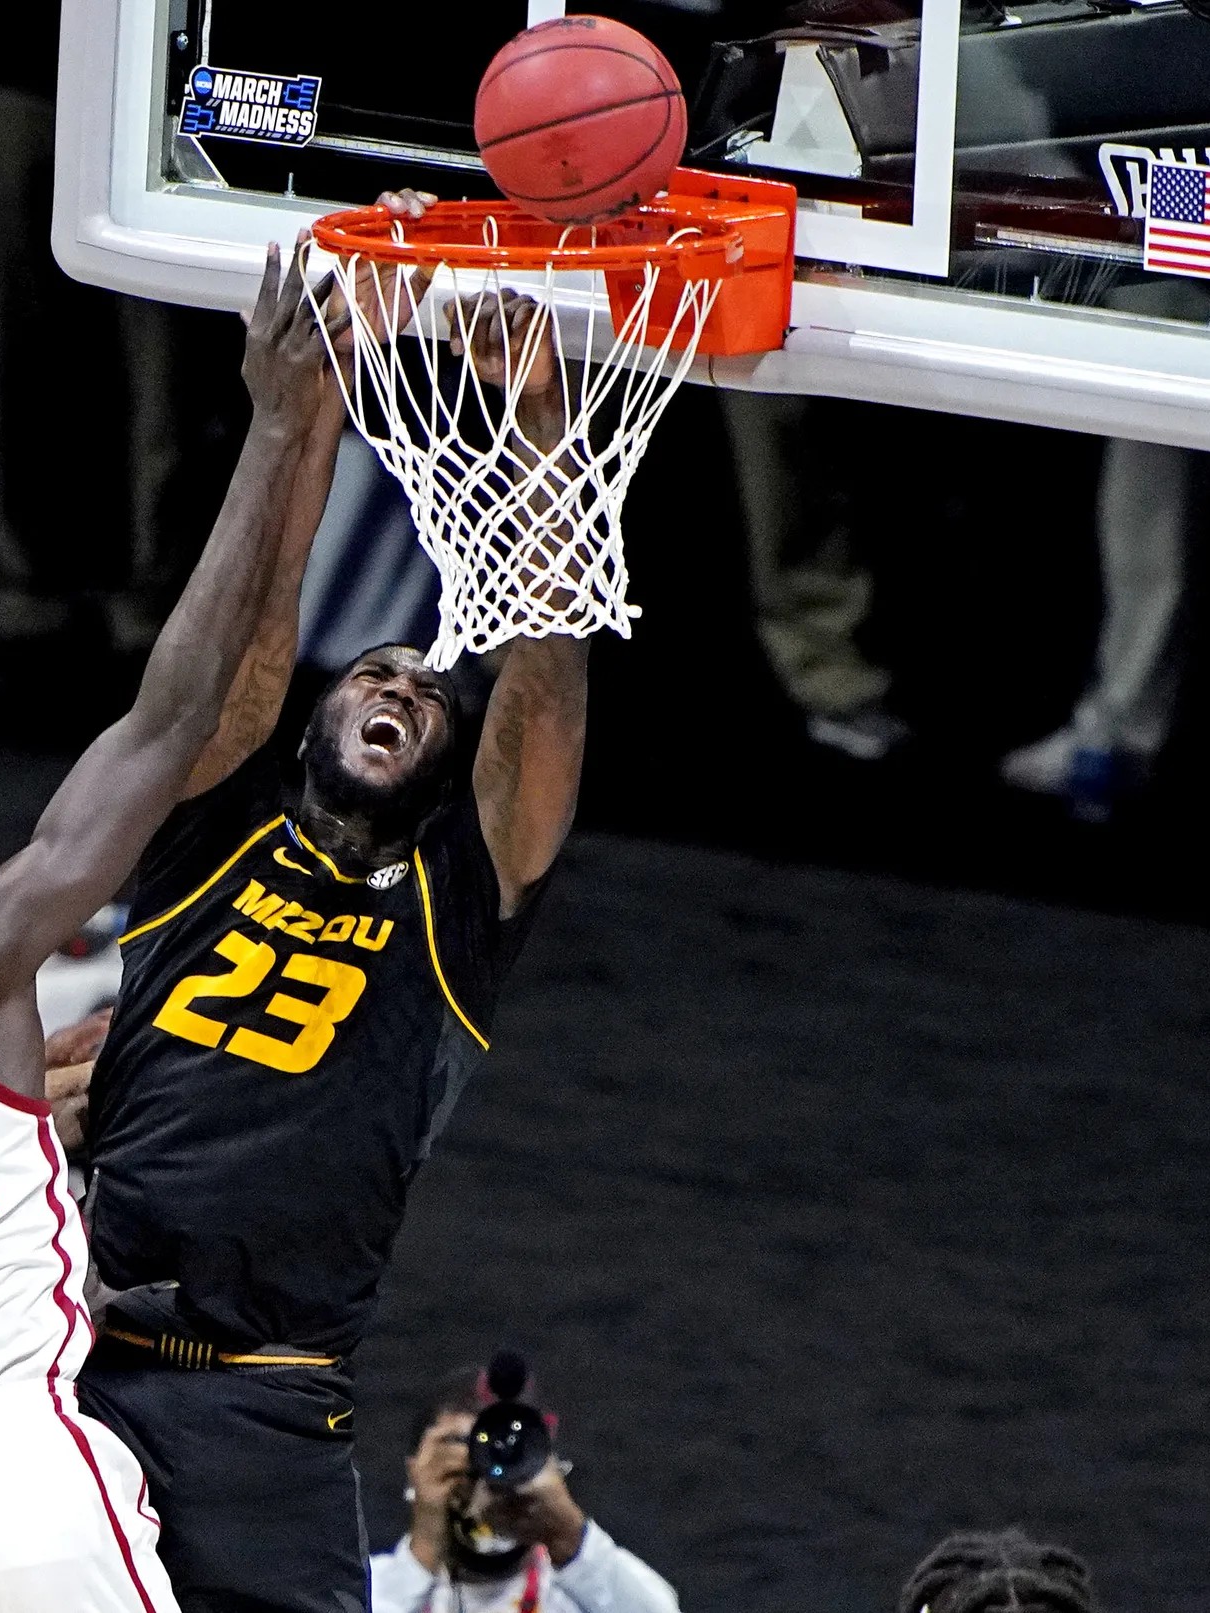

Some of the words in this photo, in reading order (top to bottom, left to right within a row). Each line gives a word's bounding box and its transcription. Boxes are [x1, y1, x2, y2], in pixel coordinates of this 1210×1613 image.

[212, 73, 283, 106] MARCH
[219, 100, 314, 136] MADNESS
[152, 930, 367, 1074] 23
